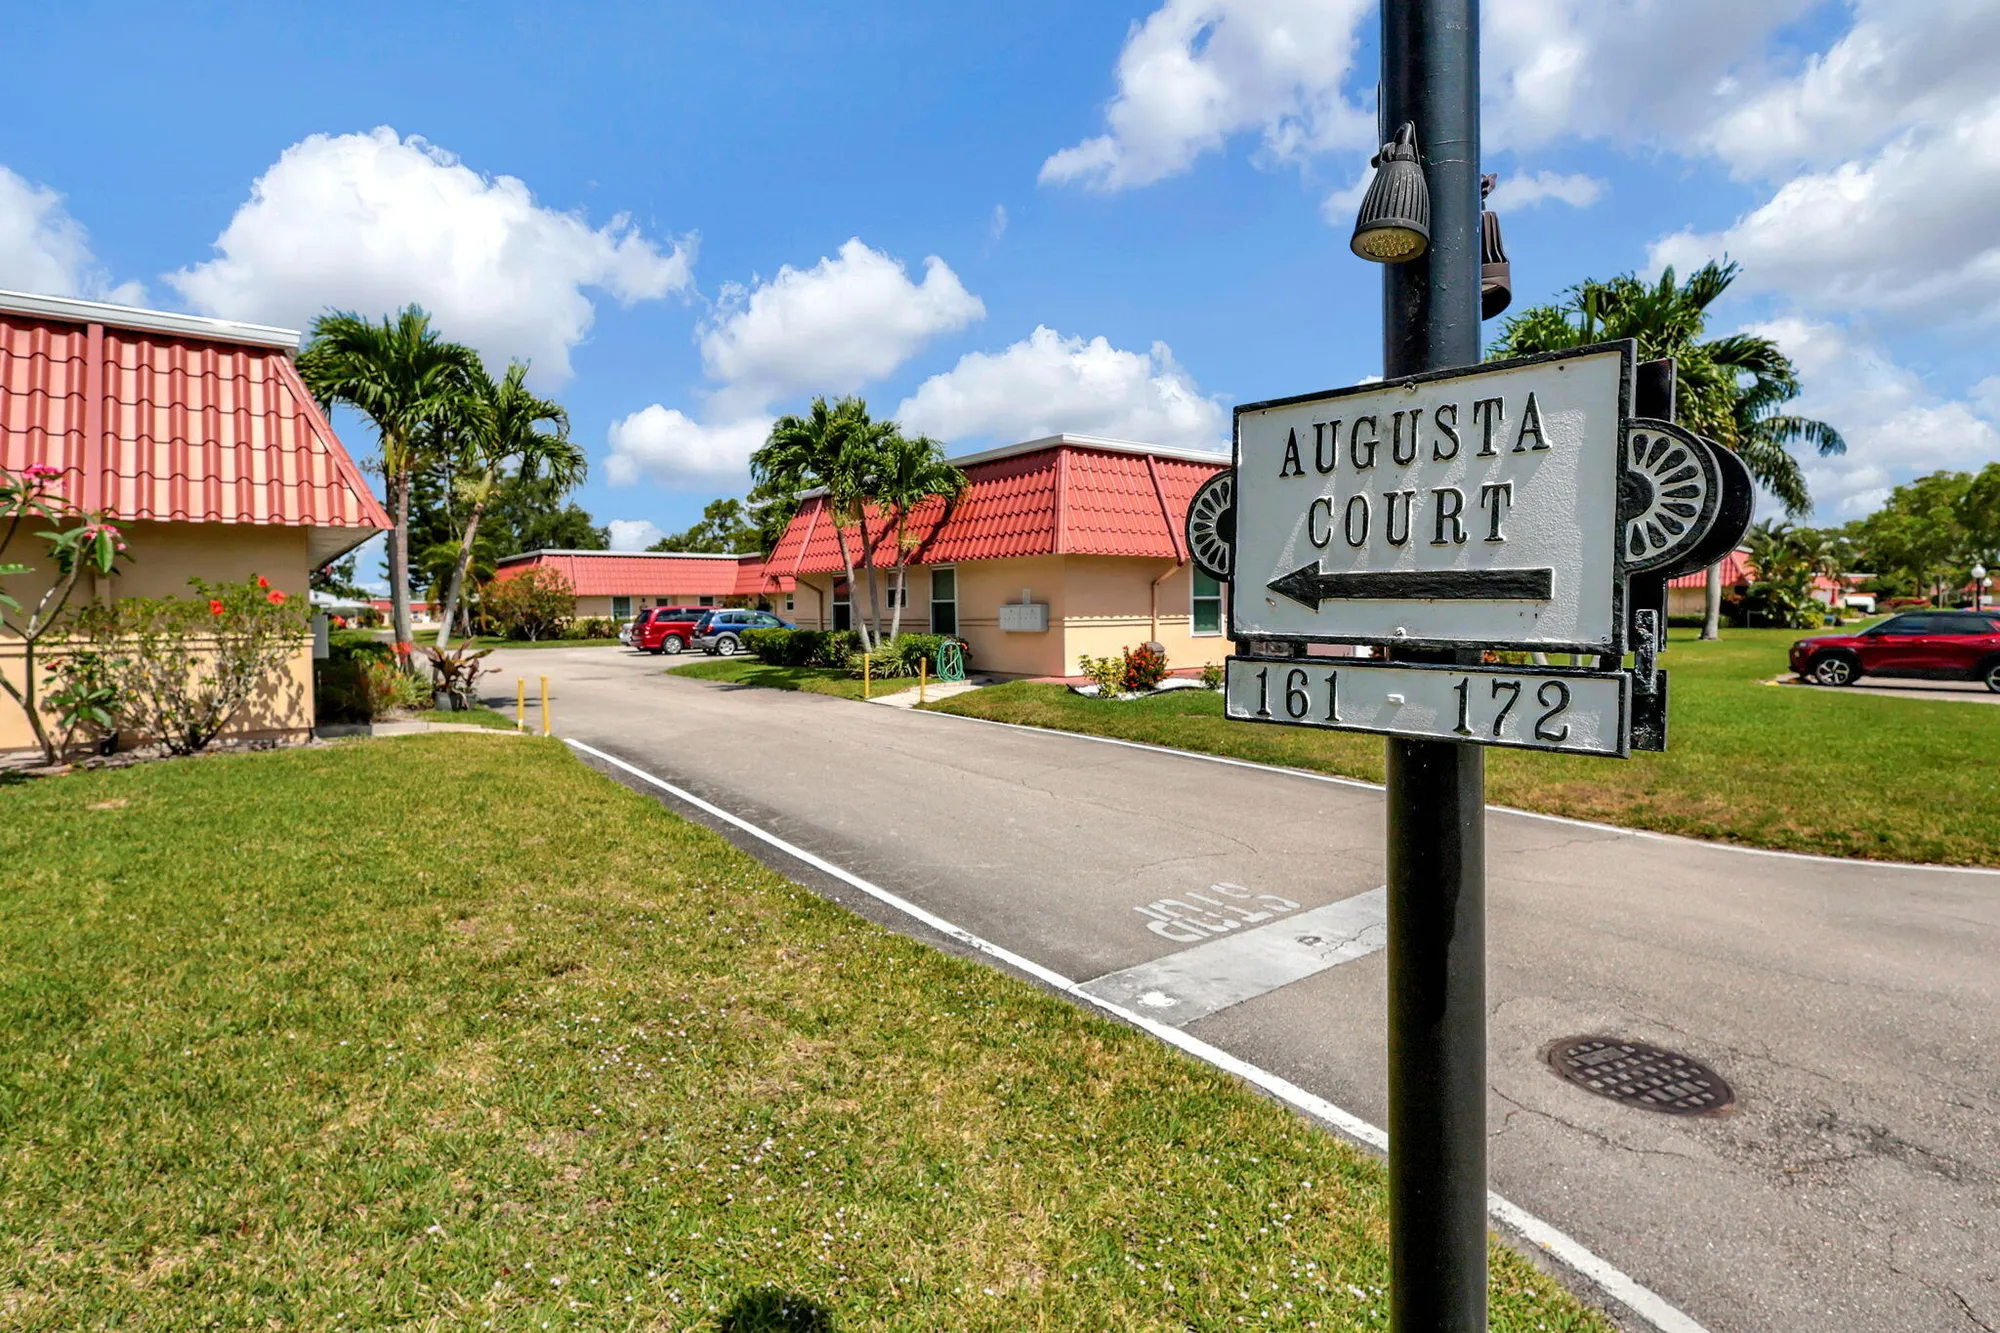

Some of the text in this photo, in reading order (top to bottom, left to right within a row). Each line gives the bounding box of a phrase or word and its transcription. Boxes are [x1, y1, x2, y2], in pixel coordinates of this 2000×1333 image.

[1279, 391, 1552, 478] AUGUSTA
[1307, 481, 1513, 549] COURT
[1255, 667, 1340, 722] 161
[1453, 676, 1571, 742] 172
